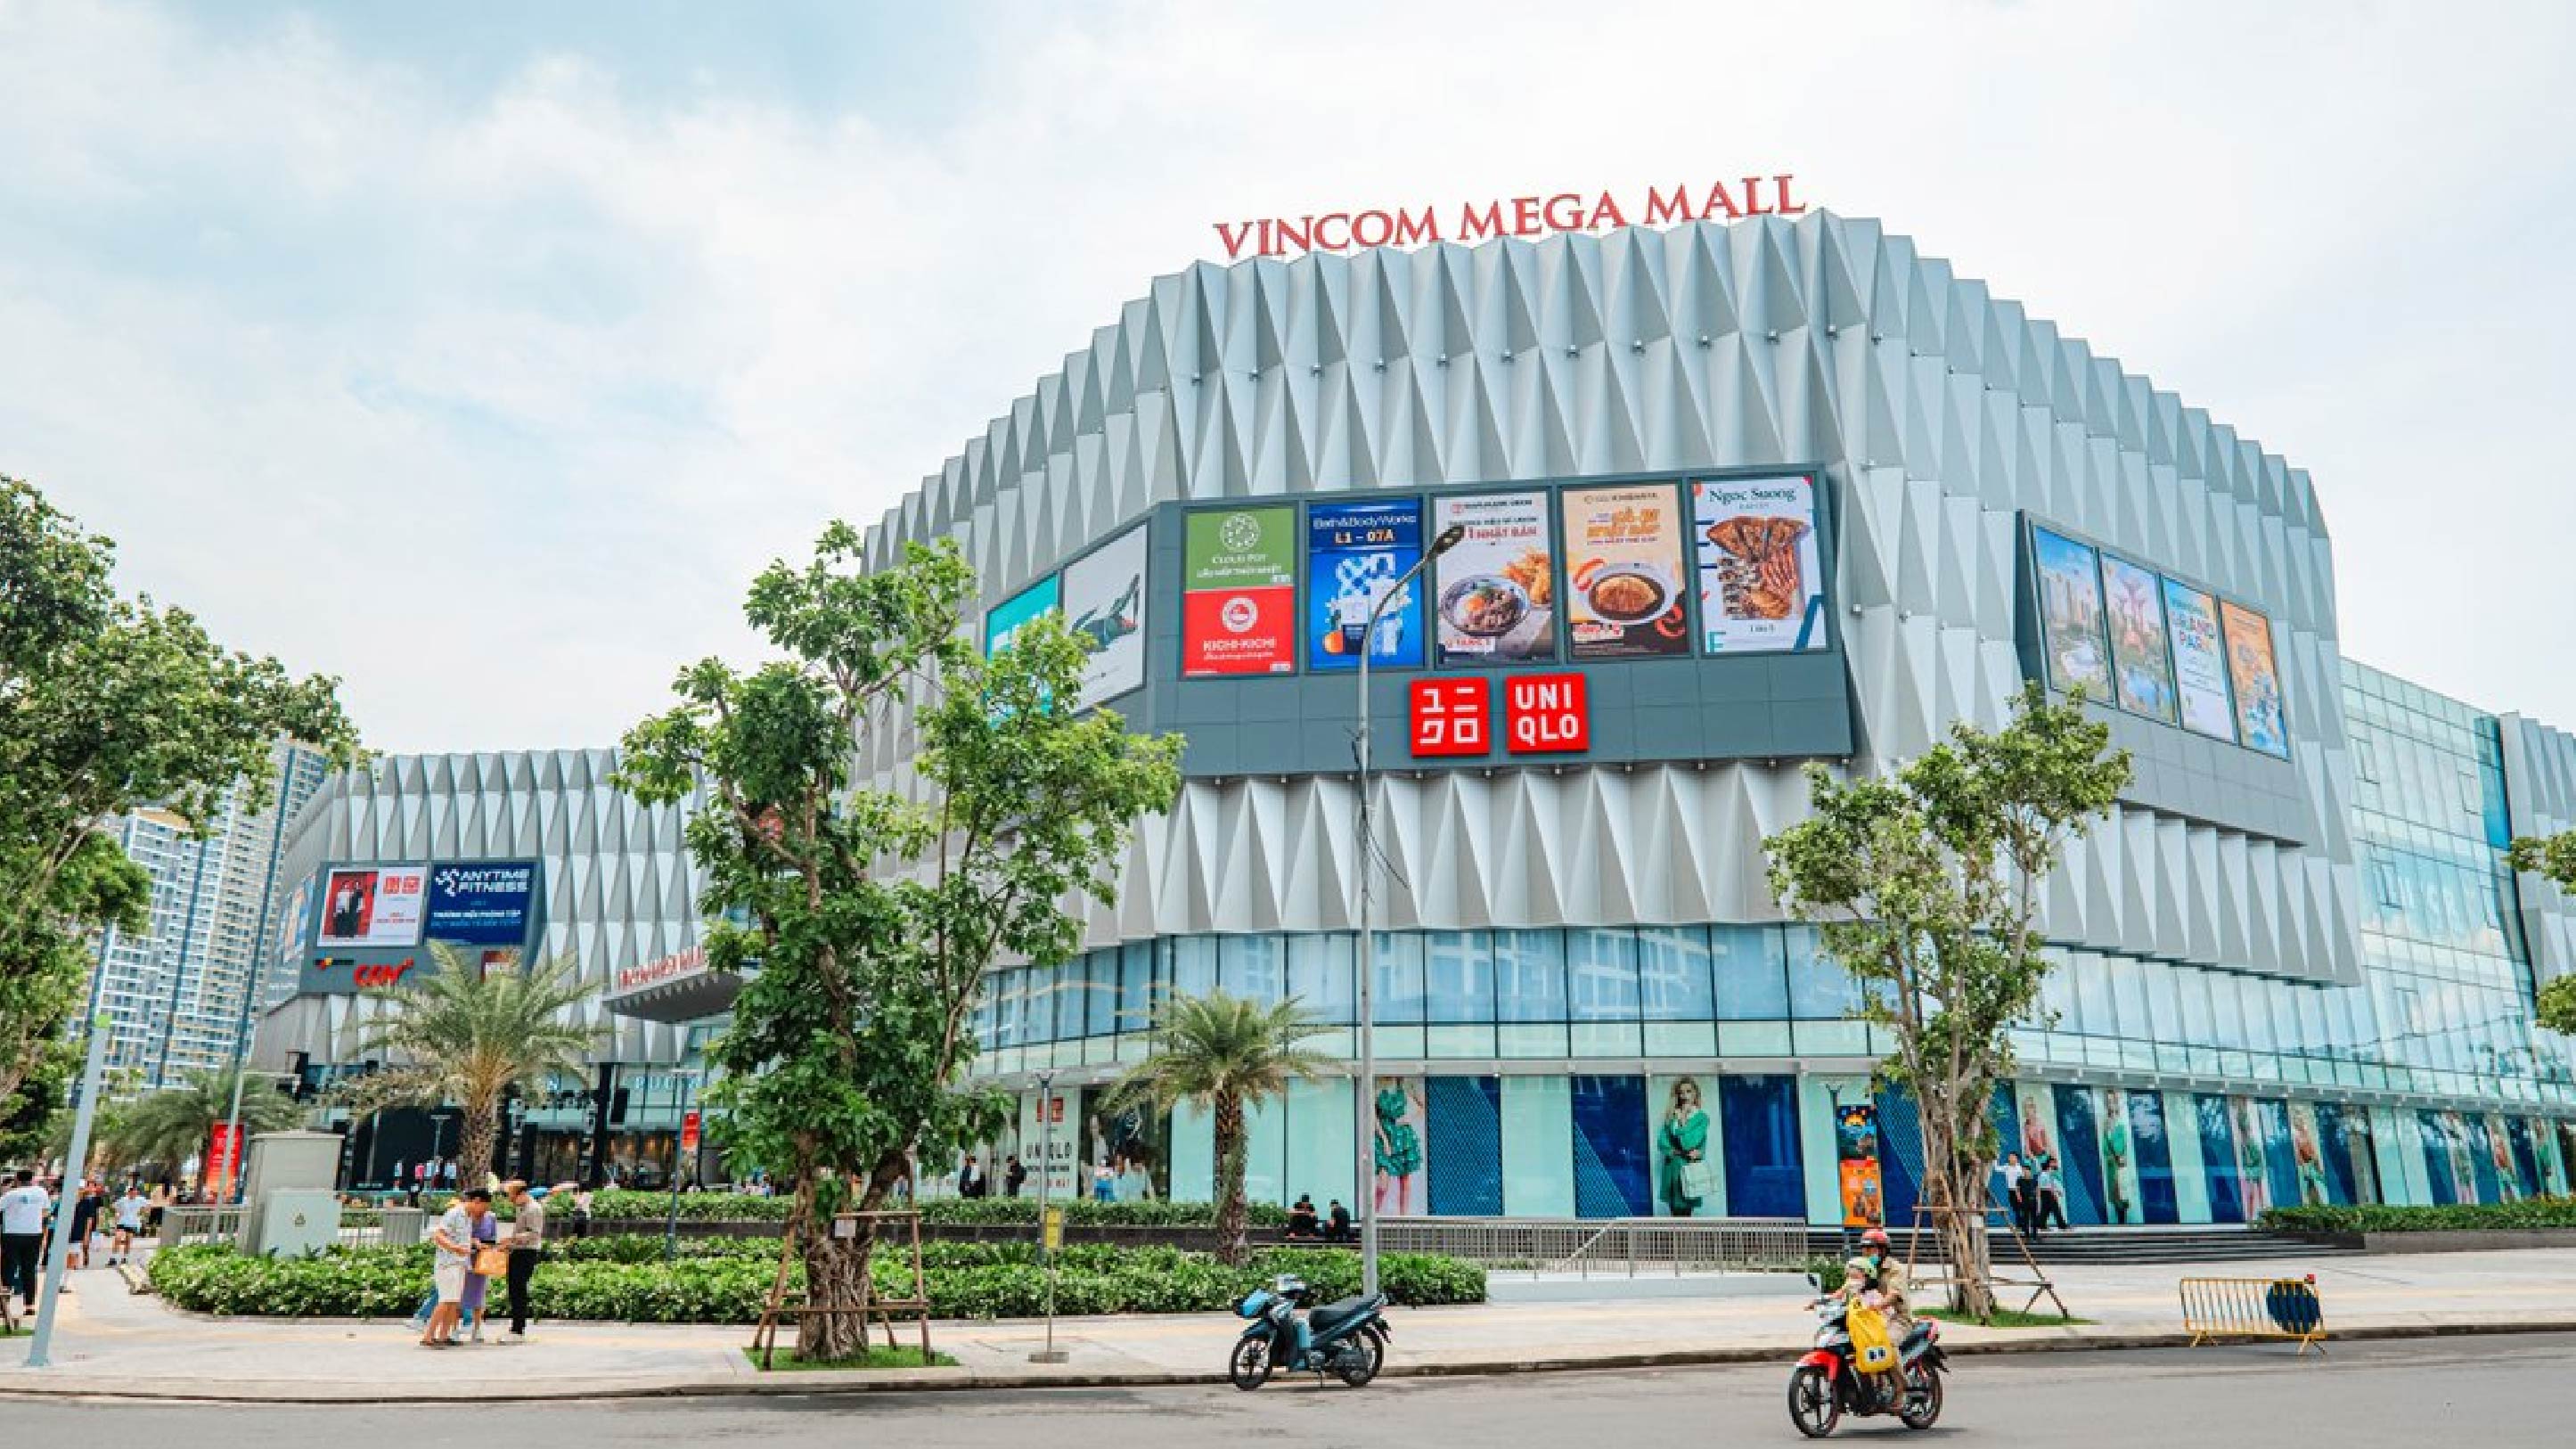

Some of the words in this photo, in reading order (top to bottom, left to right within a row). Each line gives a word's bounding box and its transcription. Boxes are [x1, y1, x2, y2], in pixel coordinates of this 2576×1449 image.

[1213, 205, 1443, 258] VINCOM
[1457, 189, 1630, 241] MEGA
[1644, 174, 1806, 225] MALL
[1515, 681, 1572, 710] UNI
[1517, 713, 1579, 746] QLO
[459, 868, 530, 881] ANYTIME
[457, 881, 528, 893] FITNESS
[1026, 1142, 1073, 1160] UNQLO
